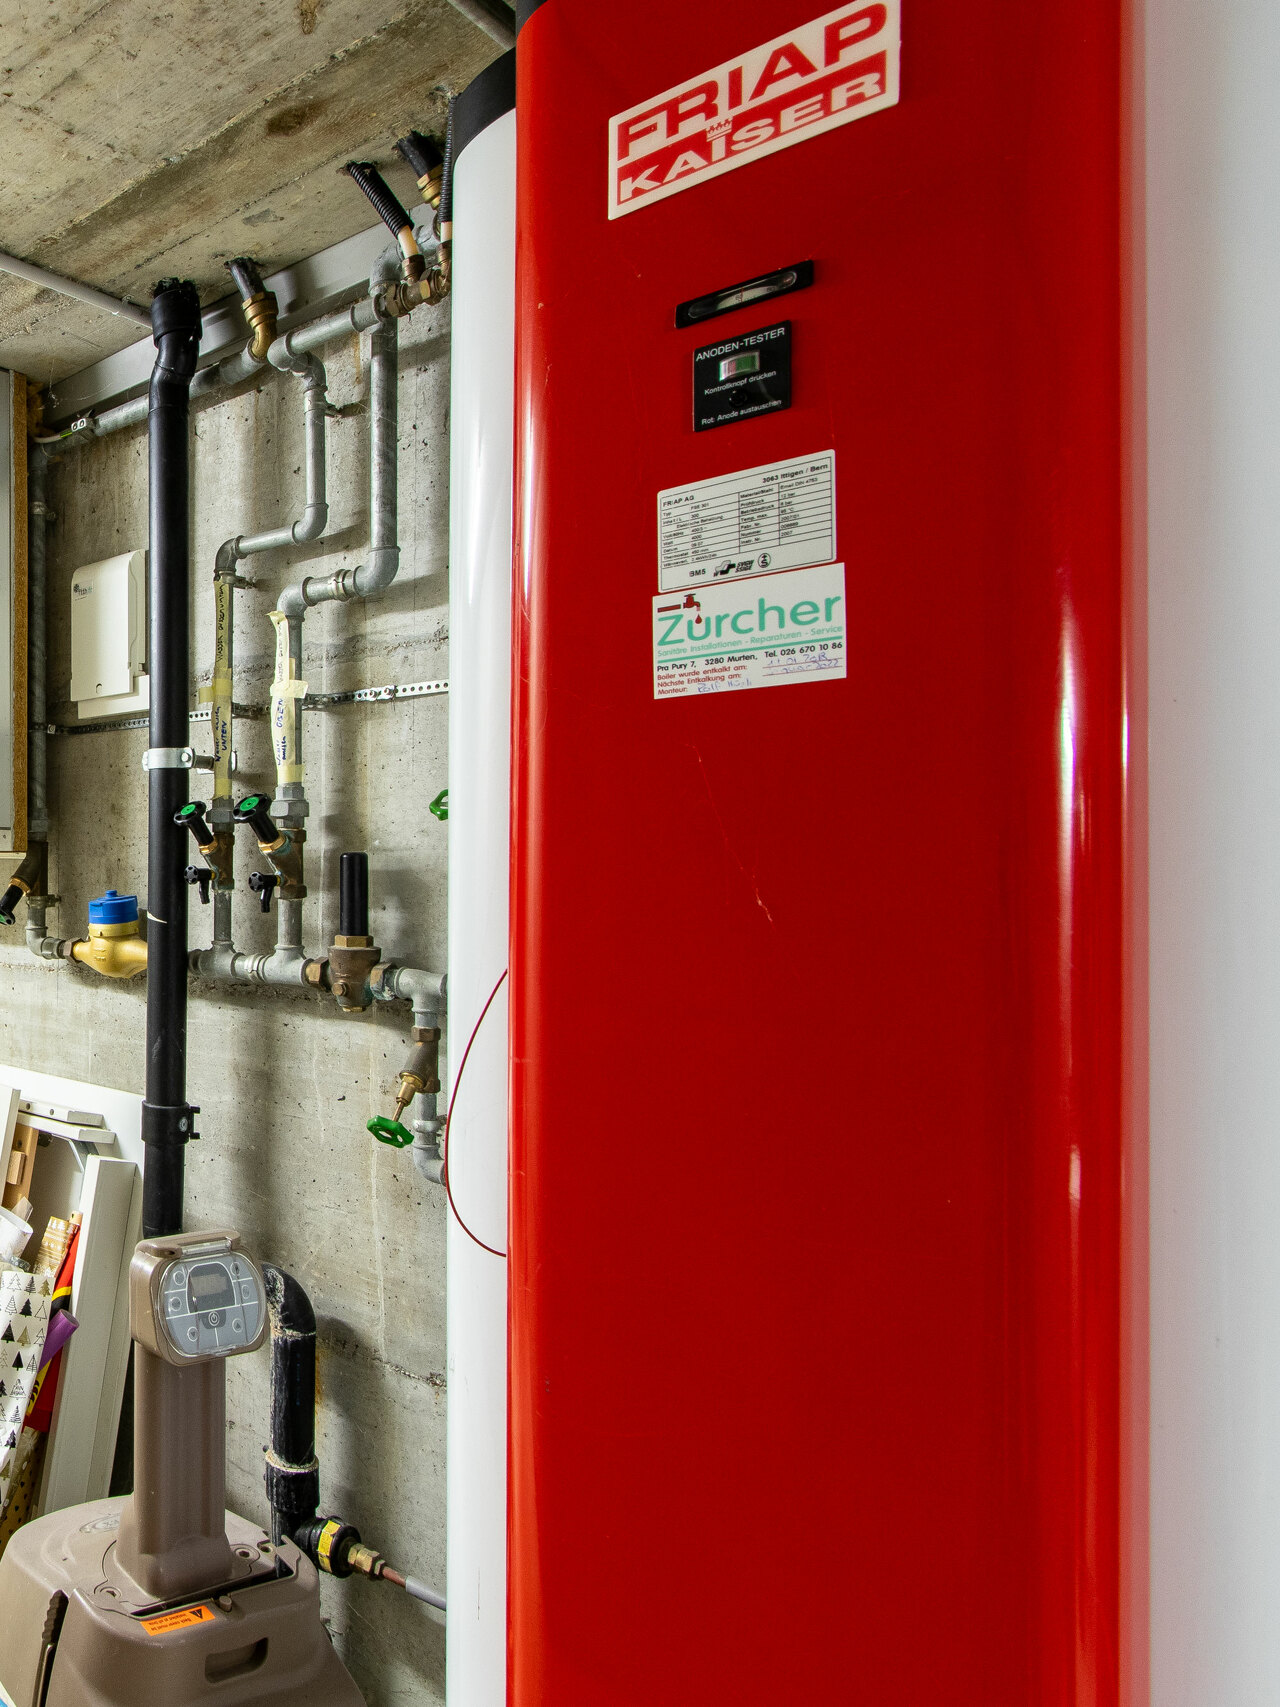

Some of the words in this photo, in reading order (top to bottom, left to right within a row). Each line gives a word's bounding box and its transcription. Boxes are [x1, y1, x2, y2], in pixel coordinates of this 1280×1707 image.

[617, 3, 887, 162] FRIAP
[620, 72, 881, 202] KAISER
[696, 327, 785, 362] ANODEN-TESTER
[704, 378, 747, 395] Kontrollknopf
[717, 411, 738, 421] Anode
[740, 400, 781, 416] austauschen
[762, 475, 779, 483] 3063
[780, 469, 803, 480] Ittigen
[810, 464, 828, 472] Bern
[663, 498, 682, 507] FRIAP
[691, 639, 742, 652] Installationen
[750, 631, 802, 644] Reparaturen
[811, 625, 842, 636] Service
[672, 662, 687, 671] Pury
[705, 657, 724, 666] 3280
[781, 648, 796, 656] 026
[800, 645, 815, 654] 670
[658, 672, 676, 681] Boiler
[679, 670, 700, 678] wurde
[703, 666, 730, 675] entkalkt
[687, 675, 725, 685] Entkalkung
[658, 686, 688, 695] Monteur:
